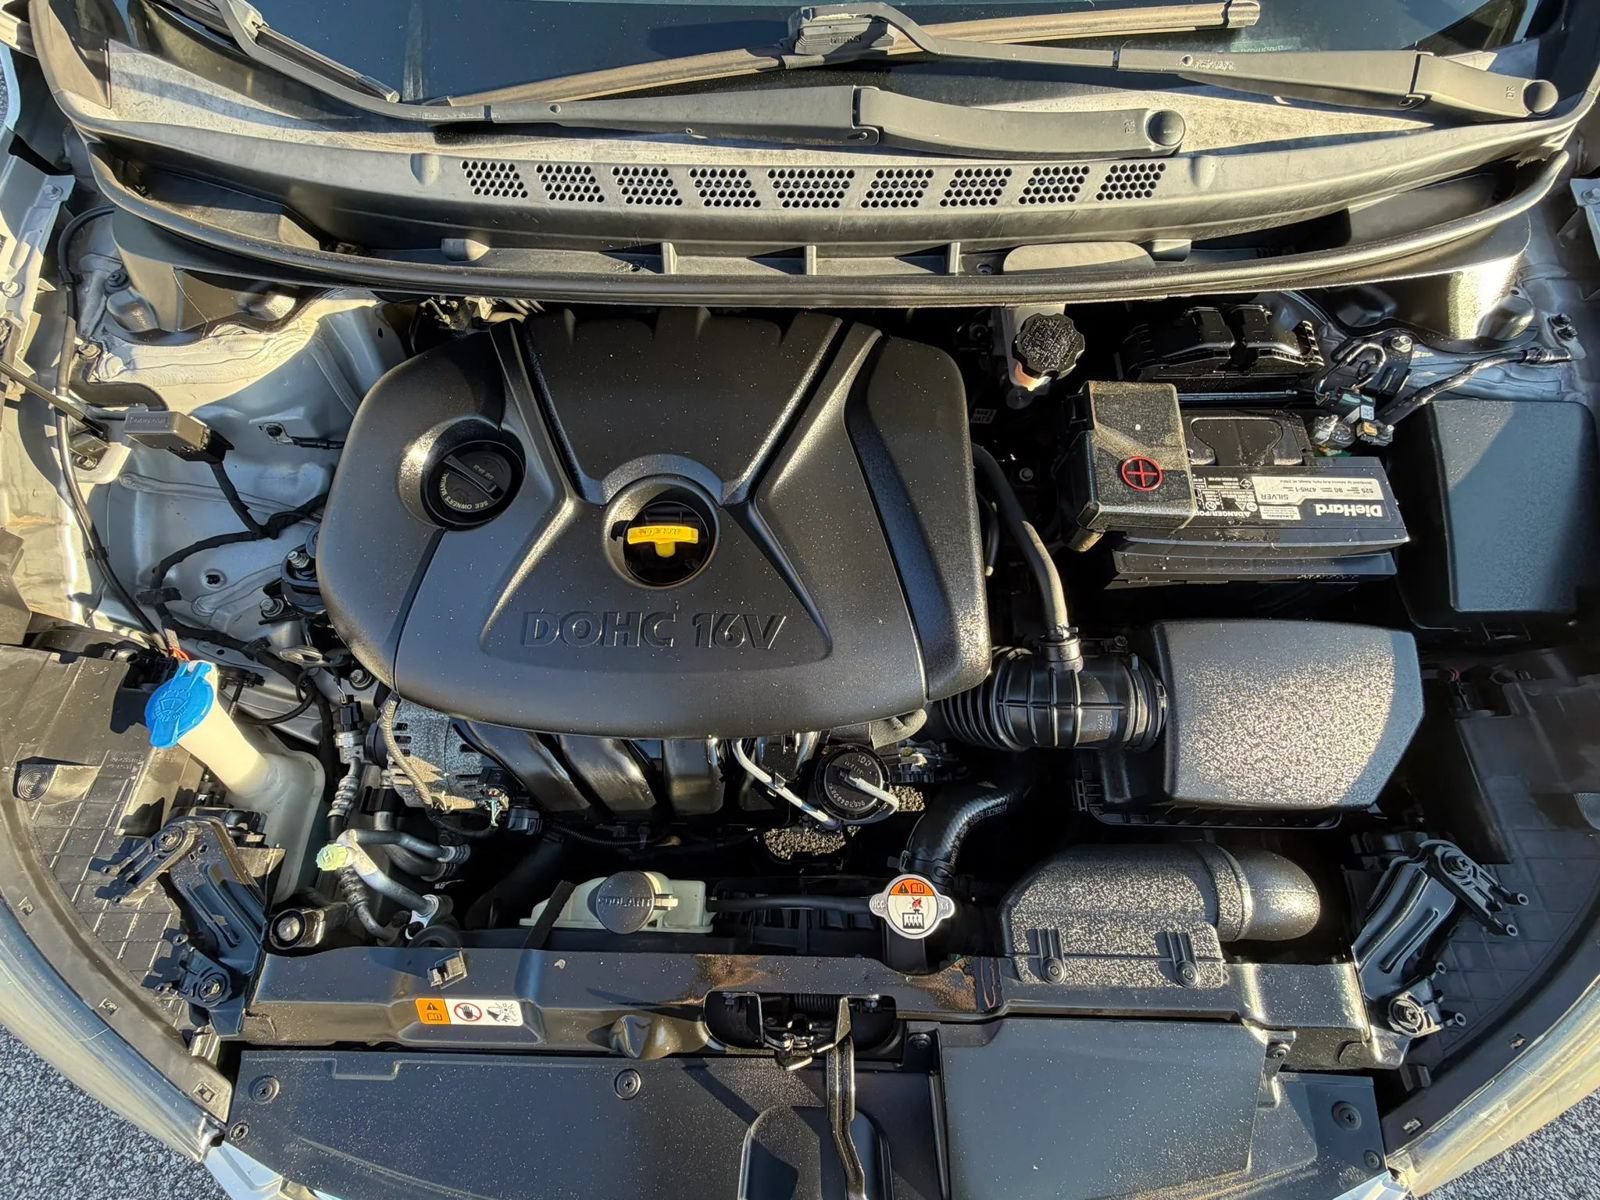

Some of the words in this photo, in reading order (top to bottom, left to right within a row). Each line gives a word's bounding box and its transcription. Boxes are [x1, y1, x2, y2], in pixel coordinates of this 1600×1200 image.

[474, 500, 489, 509] SEE
[1314, 504, 1383, 517] DieHard
[521, 611, 676, 648] DOHC
[692, 613, 786, 649] 16V
